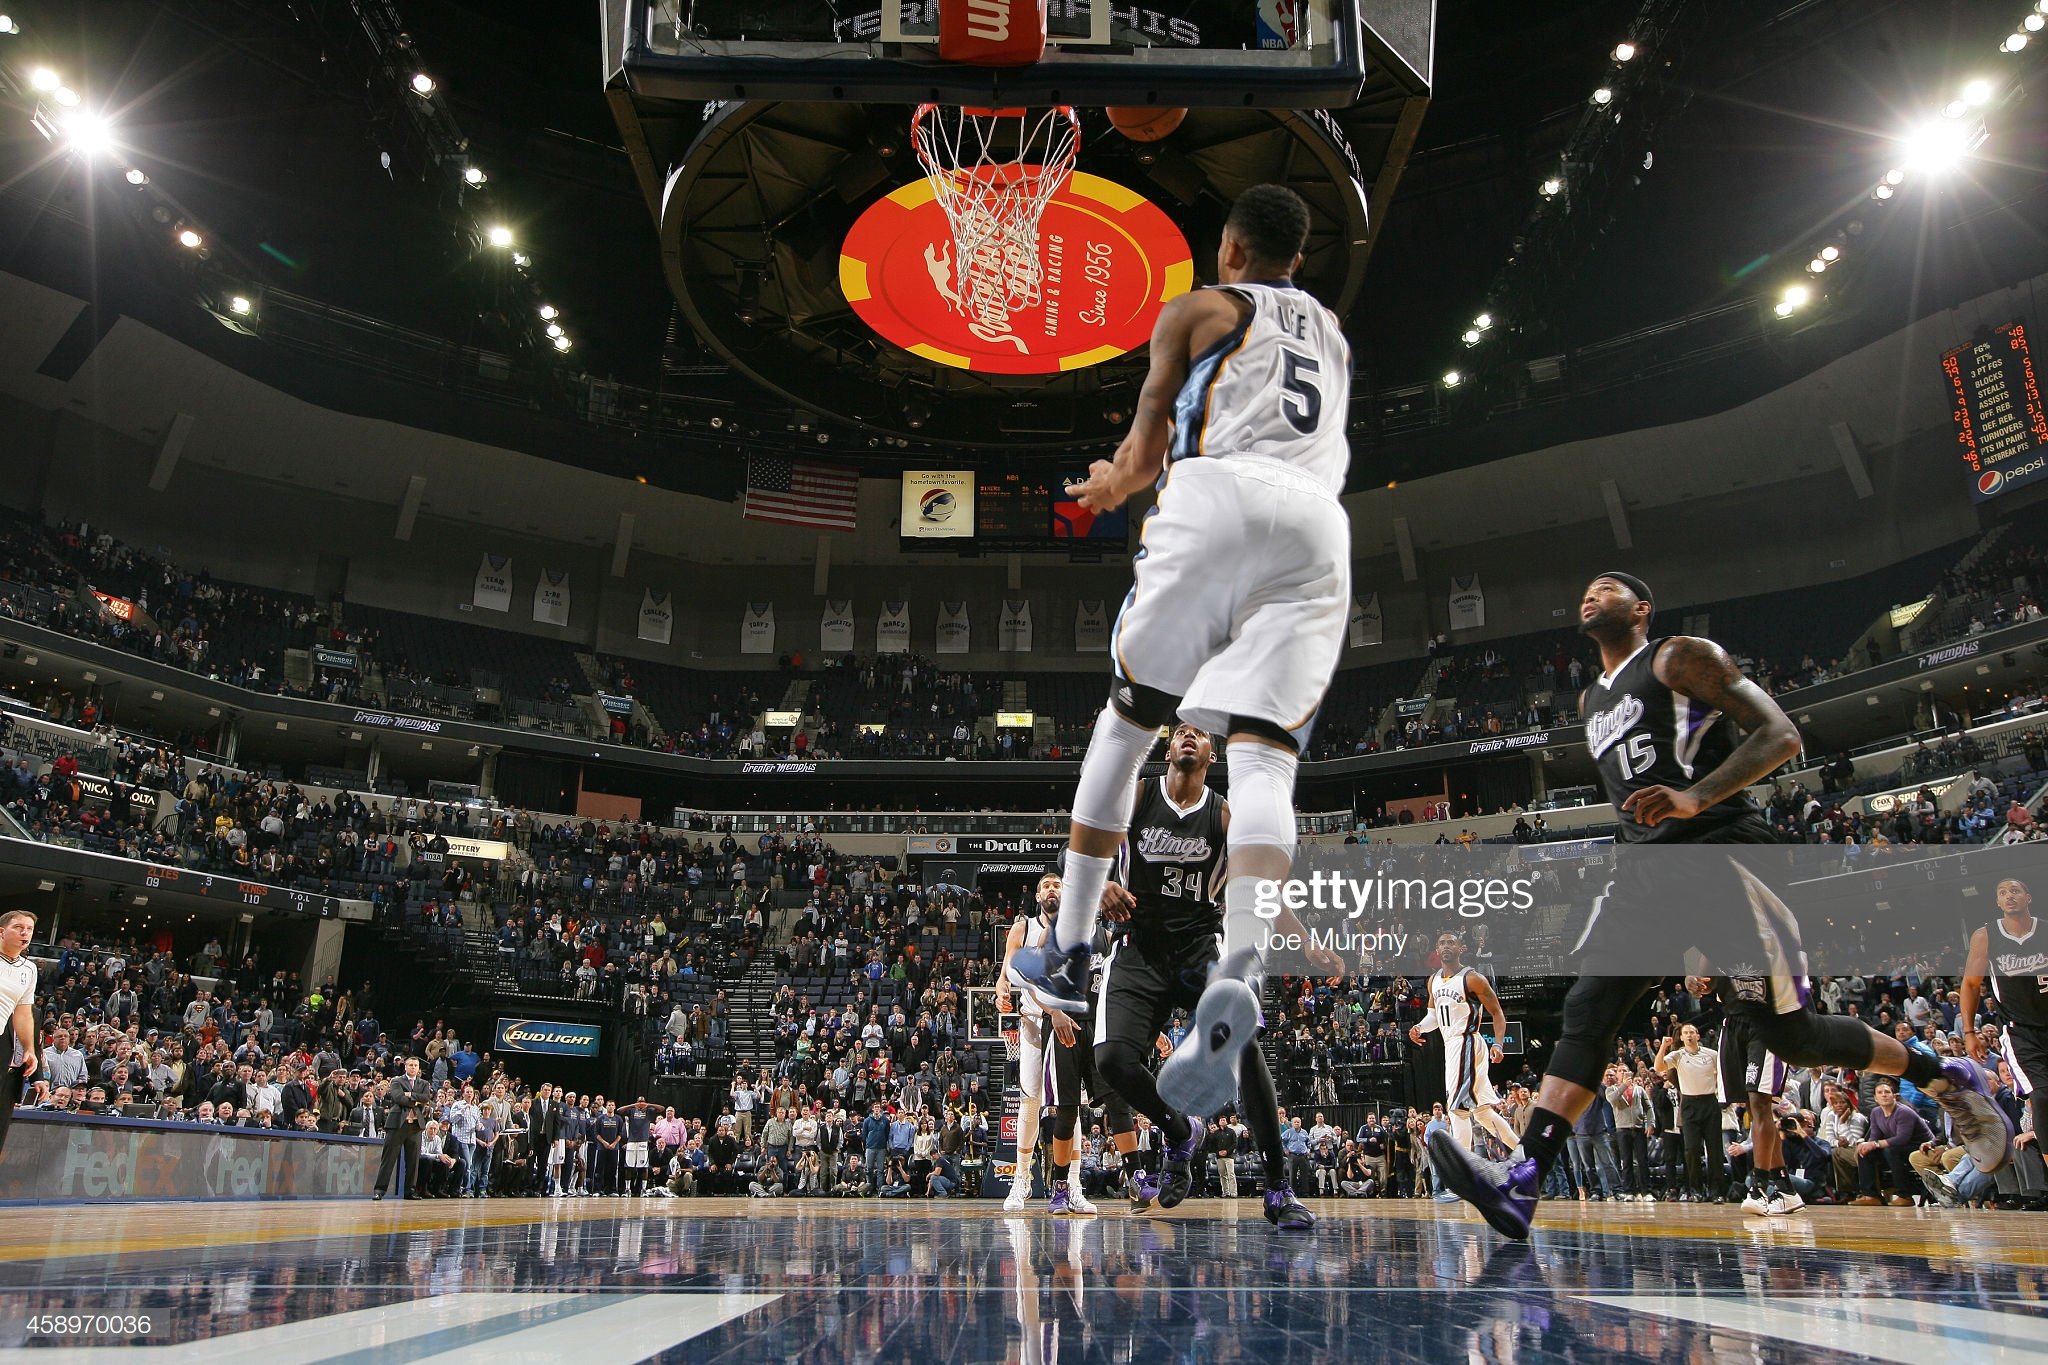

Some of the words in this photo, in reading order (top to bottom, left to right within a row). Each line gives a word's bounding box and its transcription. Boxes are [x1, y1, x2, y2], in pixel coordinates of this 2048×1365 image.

[1262, 39, 1283, 48] NBA
[1047, 234, 1064, 284] RACING
[1084, 241, 1113, 286] 1956
[1052, 288, 1061, 297] &
[1078, 288, 1107, 327] Since
[1045, 299, 1060, 337] GAMING
[1973, 343, 1991, 355] FG%
[1976, 353, 1993, 365] FT%
[1970, 370, 1976, 379] 3
[1977, 365, 1988, 377] PT
[1988, 358, 2003, 373] FGS
[1974, 370, 2004, 389] BLOCKS
[1279, 345, 1322, 435] 5
[1977, 381, 2006, 399] STEALS
[1979, 391, 2010, 410] ASSISTS
[1996, 402, 2013, 415] REB.
[1998, 413, 2015, 426] REB.
[1979, 421, 2024, 444] TURNOVERS
[1981, 443, 1995, 456] PTS
[1996, 441, 2004, 450] IN
[2005, 431, 2027, 447] PAINT
[1984, 447, 2017, 466] FASTBREAK
[2016, 442, 2030, 454] PTS
[2005, 456, 2046, 483] pepsi
[1926, 641, 1979, 666] Memphis
[353, 711, 393, 726] Greater
[394, 716, 441, 732] Memphis
[1469, 740, 1504, 753] Greater
[1505, 732, 1549, 747] Memphis
[1617, 733, 1656, 780] 15
[742, 762, 776, 773] Greater
[776, 762, 817, 774] Memphis
[79, 780, 109, 795] NICA
[1876, 797, 1891, 806] FOX
[984, 838, 1033, 854] Draft
[1137, 827, 1212, 863] Kings
[980, 863, 1010, 873] Greater
[1010, 864, 1045, 873] Memphis
[239, 883, 268, 896] KINGS
[1161, 866, 1203, 902] 34
[243, 894, 260, 905] 110
[290, 893, 310, 903] T.O.L
[322, 907, 329, 916] 5
[1996, 952, 2048, 977] Kings
[1440, 1005, 1450, 1027] 11
[509, 1031, 546, 1042] BUD
[545, 1033, 594, 1045] LIGHT
[62, 1129, 180, 1197] FedEx
